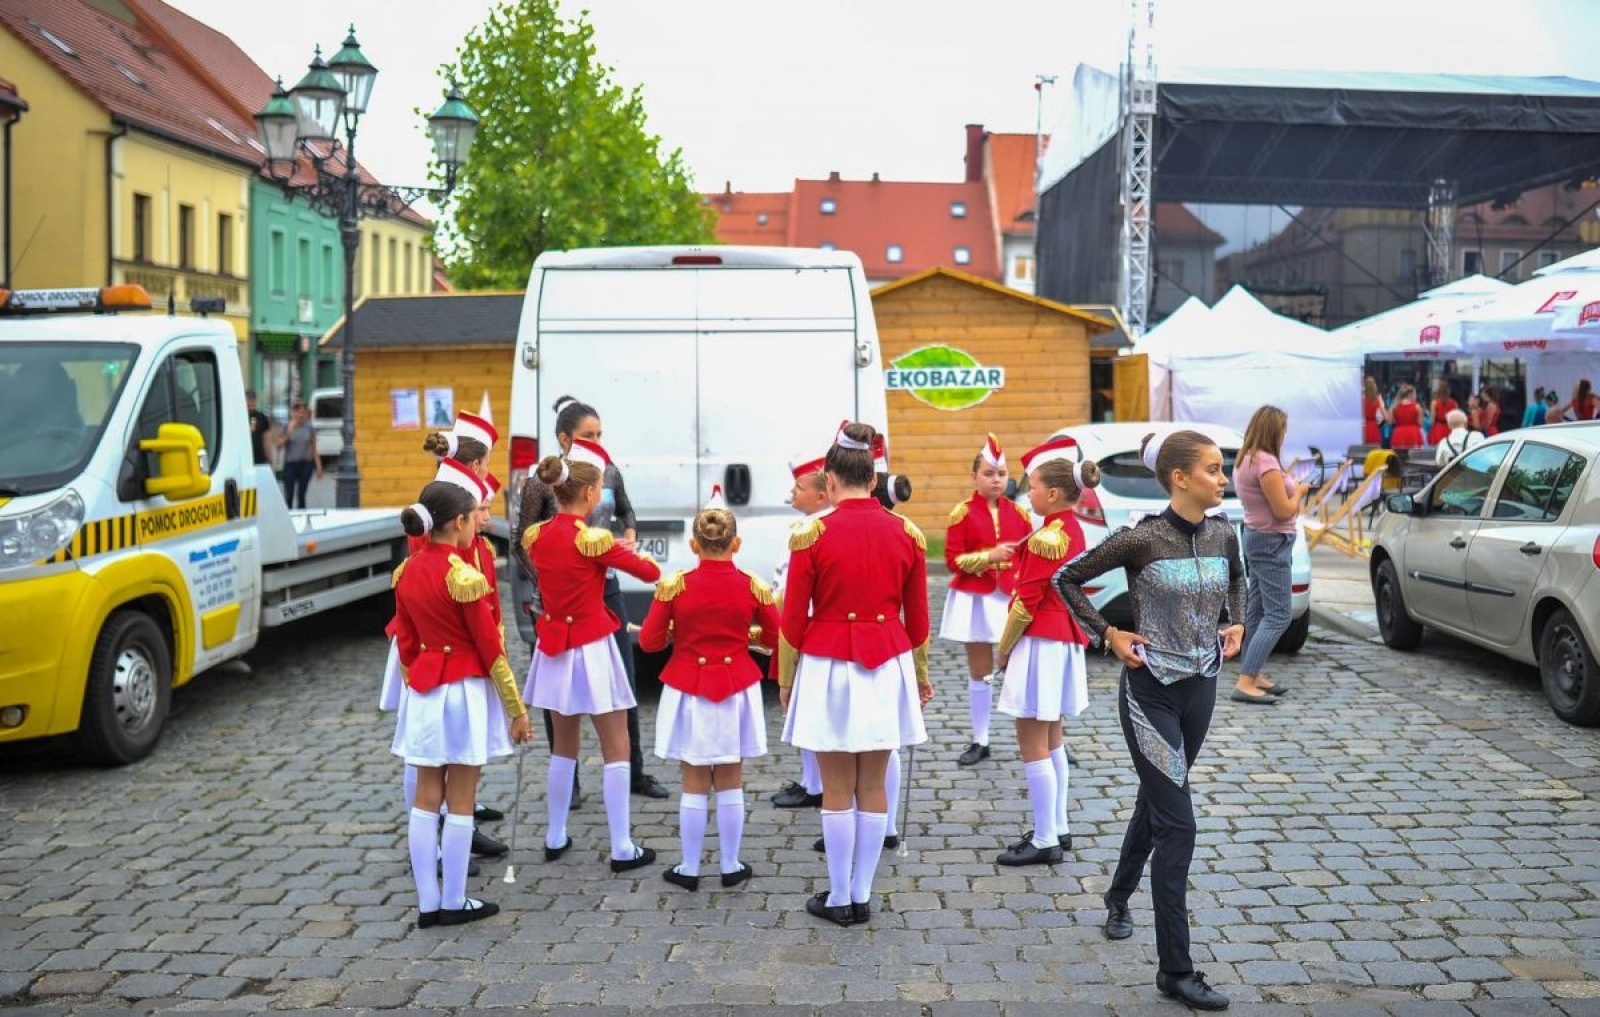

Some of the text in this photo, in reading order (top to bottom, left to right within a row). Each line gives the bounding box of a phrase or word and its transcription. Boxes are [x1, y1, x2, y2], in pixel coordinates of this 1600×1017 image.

[887, 369, 1001, 388] EKOBAZAR
[140, 500, 224, 537] POMOC DROGOWA
